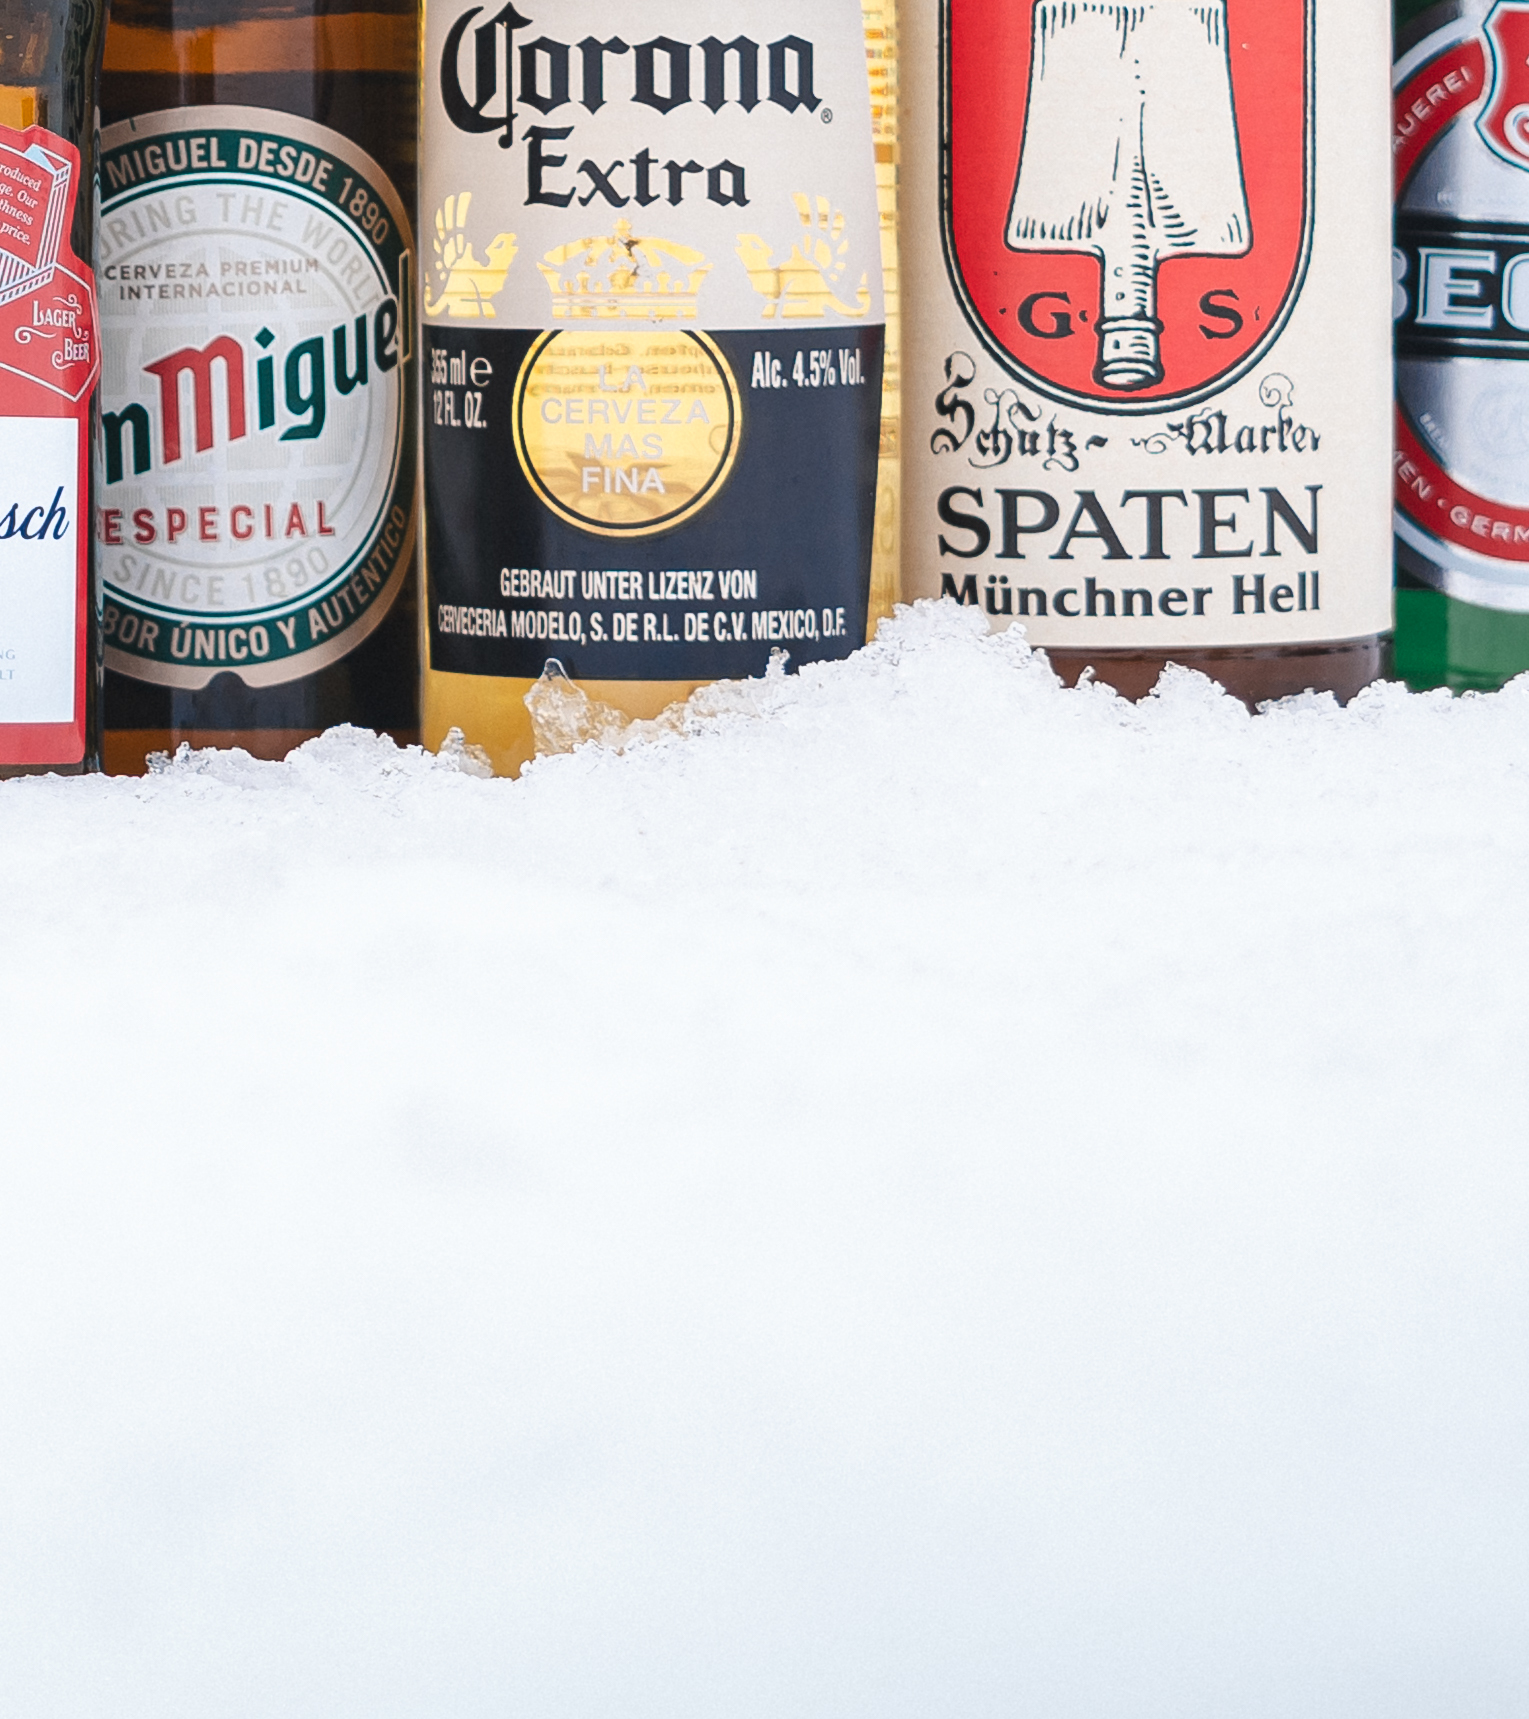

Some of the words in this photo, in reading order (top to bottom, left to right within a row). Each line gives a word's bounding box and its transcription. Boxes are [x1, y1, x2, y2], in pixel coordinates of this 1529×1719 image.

[440, 0, 823, 149] Corona
[521, 124, 751, 208] Extra
[16, 189, 39, 210] Our
[105, 136, 227, 189] MIGUEL
[237, 136, 334, 193] DESDE
[338, 176, 390, 246] 1890
[216, 191, 289, 231] THE
[0, 220, 33, 246] price.
[104, 260, 209, 281] CERVEZA
[220, 258, 320, 277] PREMIUM
[119, 279, 308, 301] INTERNACIONAL
[32, 299, 76, 329] LAGER
[1016, 291, 1077, 340] G
[1198, 288, 1244, 340] S
[598, 364, 647, 393] LA
[751, 350, 788, 389] Alc.
[792, 349, 836, 388] 4.5%
[838, 347, 866, 386] Vol.
[464, 391, 488, 429] OZ.
[540, 398, 710, 425] CERVEZA
[584, 433, 664, 461] MAS
[581, 467, 667, 495] FINA
[100, 499, 335, 545] ESPECIAL
[936, 483, 1324, 561] SPATEN
[114, 553, 225, 607] SINCE
[242, 545, 331, 605] 1890
[170, 620, 270, 661] ÚNICO
[276, 615, 296, 649] Y
[308, 504, 405, 640] AUTÉNTICO
[500, 567, 576, 600] GEBRAUT
[581, 569, 643, 600] UNTER
[648, 569, 715, 601] LIZENZ
[717, 568, 758, 600] VON
[940, 571, 1214, 618] Münchner
[1231, 570, 1322, 617] Hell
[437, 604, 507, 638] CERVECERIA
[511, 609, 587, 646] MODELO,
[613, 611, 639, 642] DE
[643, 611, 680, 642] R.L.
[684, 610, 710, 642] DE
[713, 609, 748, 642] C.V.
[751, 608, 820, 643] MEXICO,
[822, 606, 847, 638] D.F.
